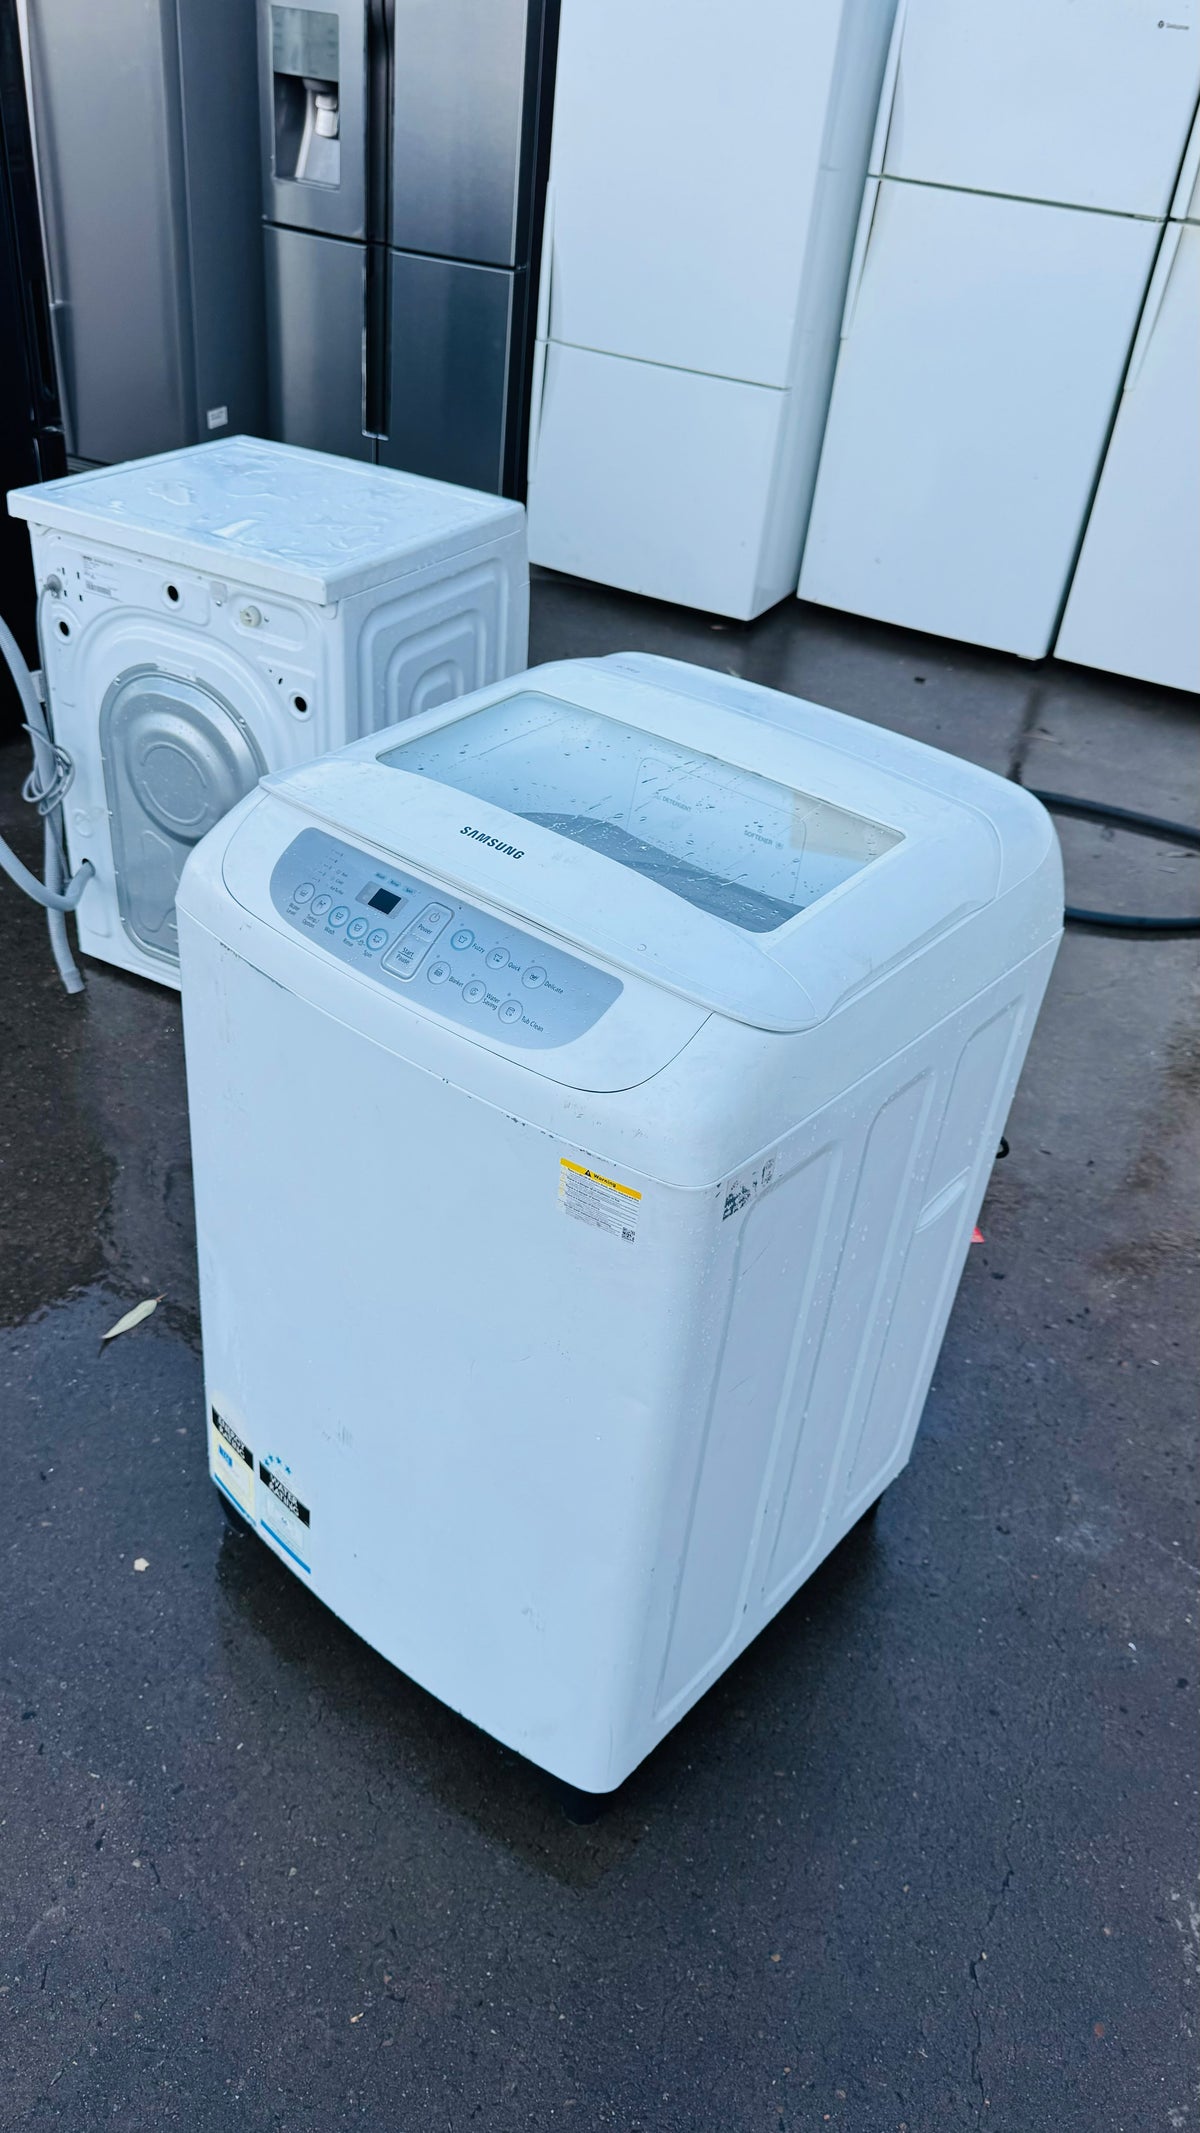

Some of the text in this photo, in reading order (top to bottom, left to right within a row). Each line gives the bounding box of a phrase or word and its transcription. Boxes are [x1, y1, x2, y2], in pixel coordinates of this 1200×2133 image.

[460, 826, 525, 859] SAMSUNG
[418, 923, 433, 935] Power
[403, 946, 414, 957] Start
[472, 943, 485, 954] Fuzzy
[396, 953, 410, 964] Pause
[508, 961, 521, 972] Quick
[448, 975, 464, 988] Blanket
[544, 980, 564, 994] Delicate
[486, 992, 500, 1003] Water
[482, 999, 498, 1011] Saving
[522, 1016, 544, 1032] Tub Clean
[593, 1173, 617, 1188] Warning
[270, 1472, 299, 1506] WATER
[268, 1481, 299, 1517] RATING
